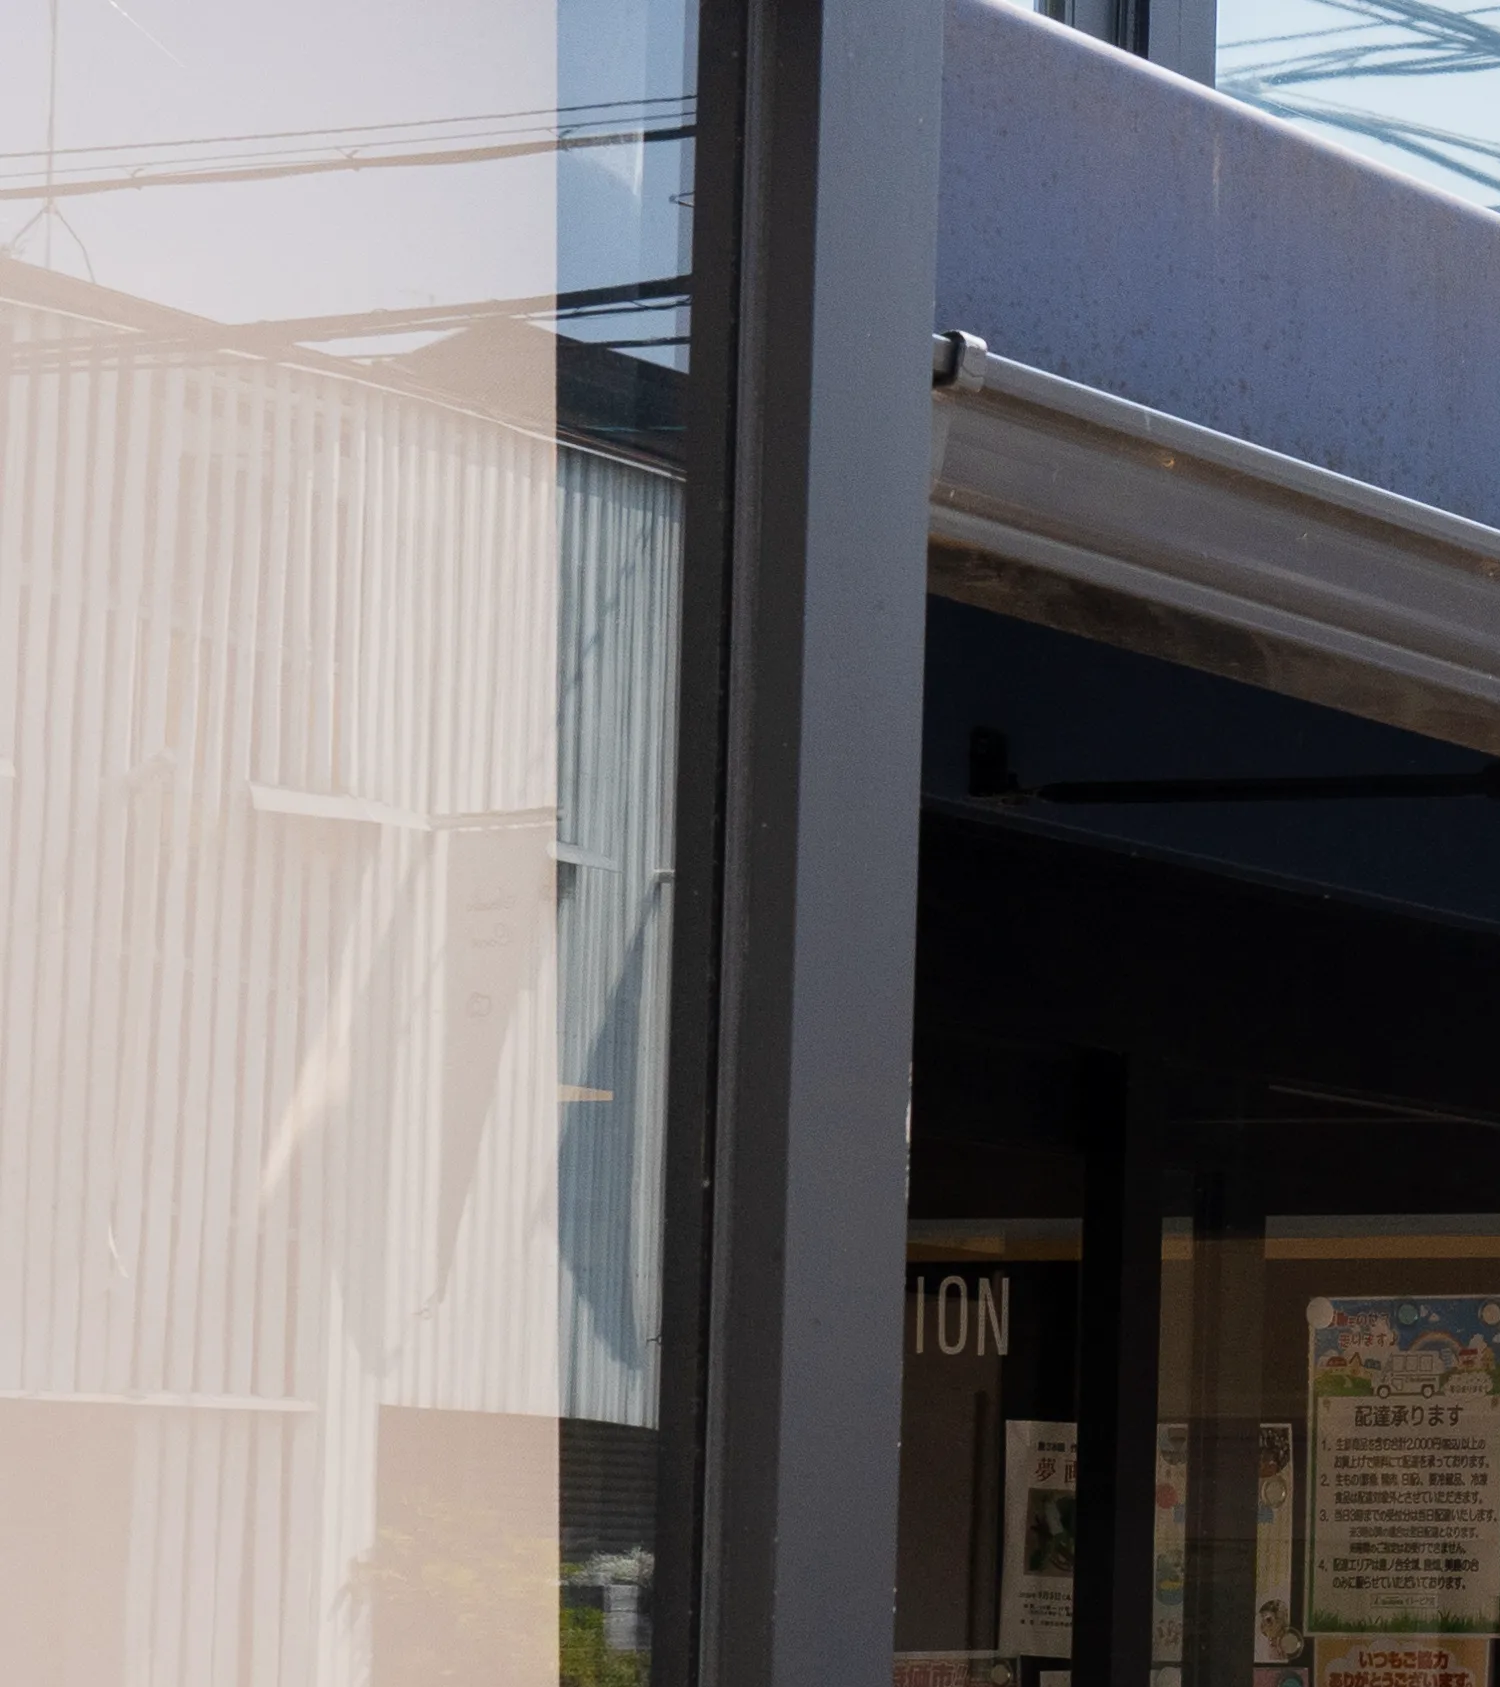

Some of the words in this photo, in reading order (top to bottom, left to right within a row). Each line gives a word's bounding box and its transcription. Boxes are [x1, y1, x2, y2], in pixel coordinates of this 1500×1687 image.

[1355, 1405, 1463, 1427] 配達承ります
